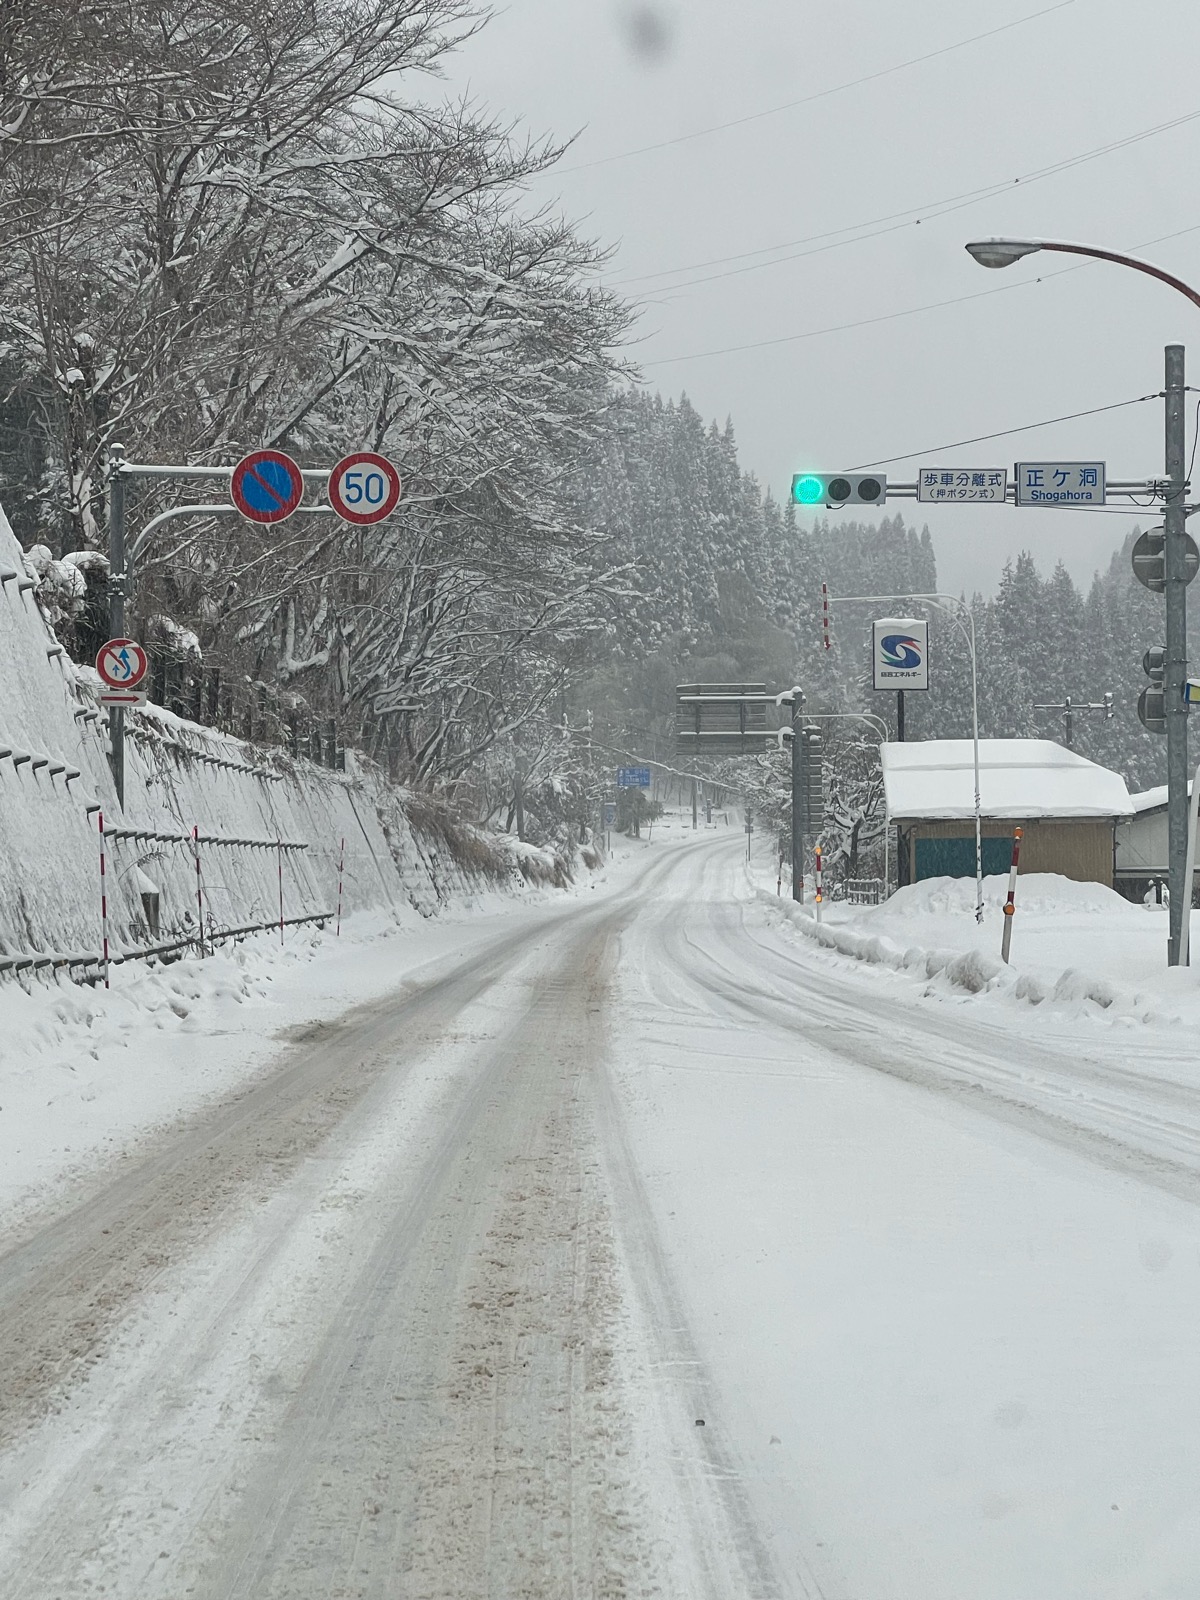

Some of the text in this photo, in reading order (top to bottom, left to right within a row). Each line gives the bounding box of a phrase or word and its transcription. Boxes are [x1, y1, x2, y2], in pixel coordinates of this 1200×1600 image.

[924, 472, 1002, 487] 歩車分離式
[1026, 468, 1098, 488] 正ケ洞
[345, 473, 384, 504] 50
[929, 488, 995, 499] （押ボタン式）
[1030, 490, 1093, 502] Shogahora
